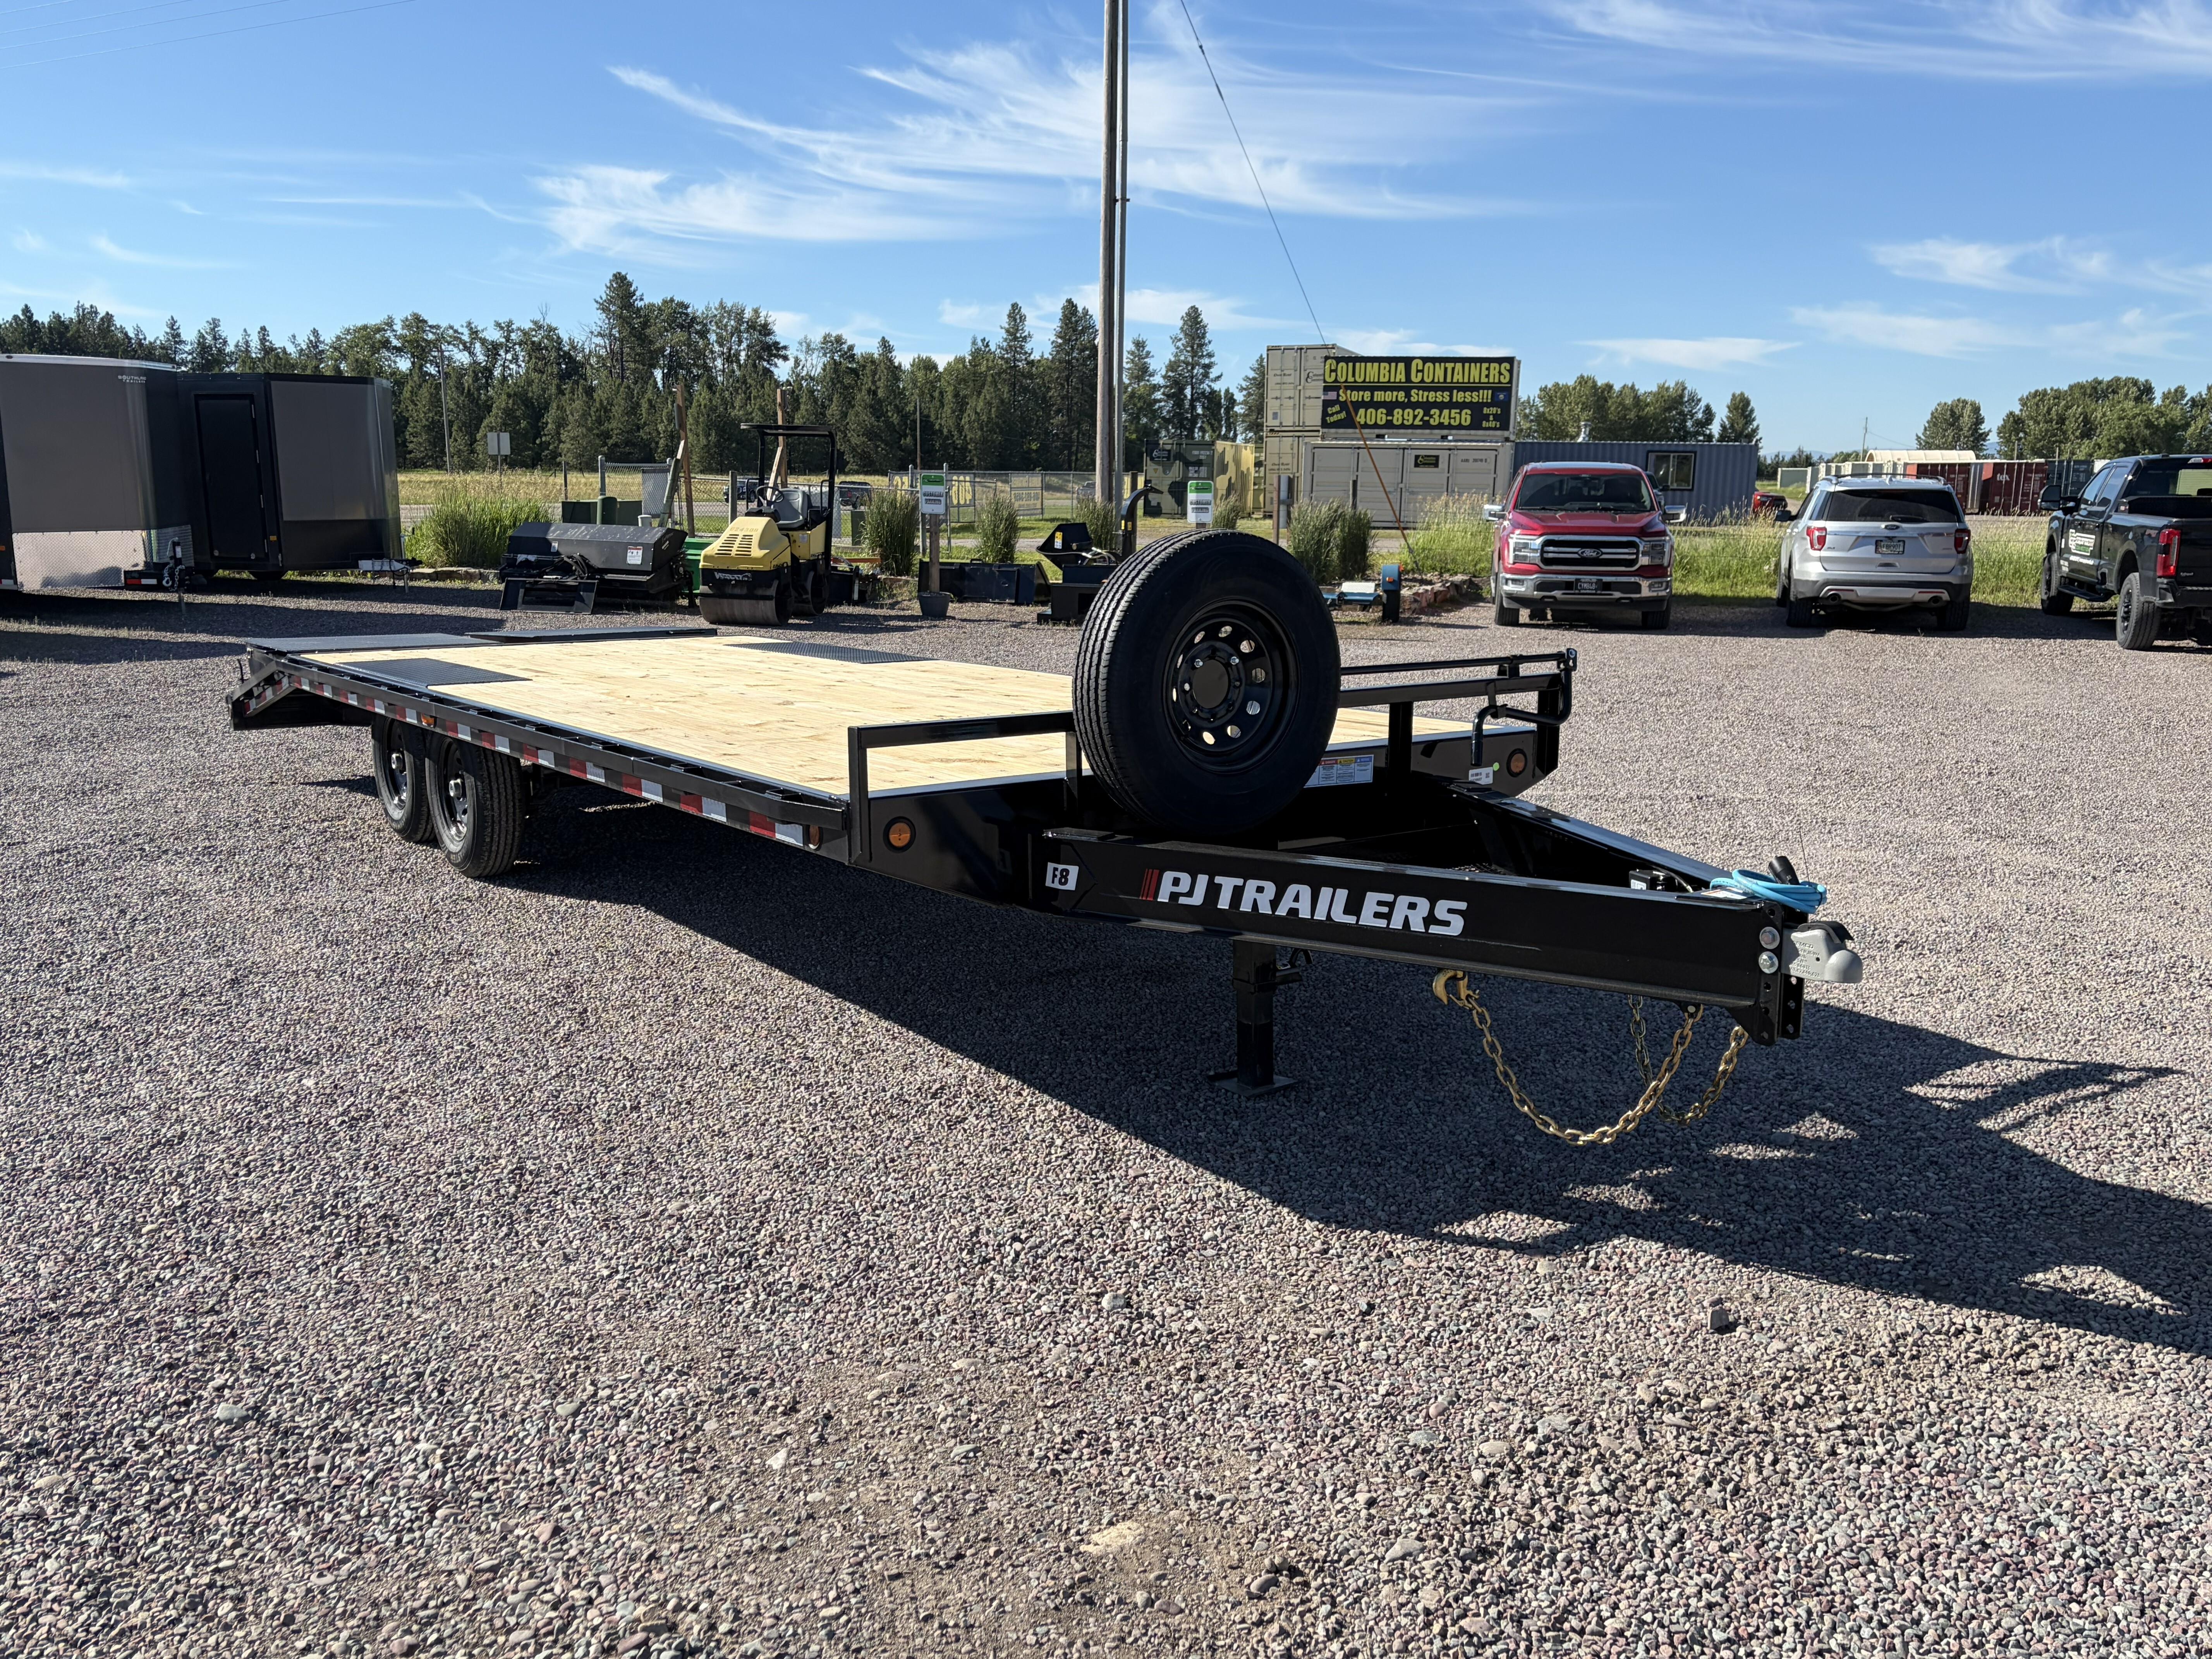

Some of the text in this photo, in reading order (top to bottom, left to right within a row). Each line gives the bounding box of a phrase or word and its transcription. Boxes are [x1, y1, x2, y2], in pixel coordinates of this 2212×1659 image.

[1325, 359, 1405, 382] COLUMBIA
[1411, 359, 1510, 383] CONTAINERS
[1339, 389, 1492, 402] Store more, Stress less!!!
[1326, 411, 1346, 423] Today!
[1328, 404, 1340, 414] Call
[1357, 408, 1471, 426] 406-892-3456
[1051, 867, 1070, 886] F8
[1157, 871, 1468, 936] PJ TRAILERS
